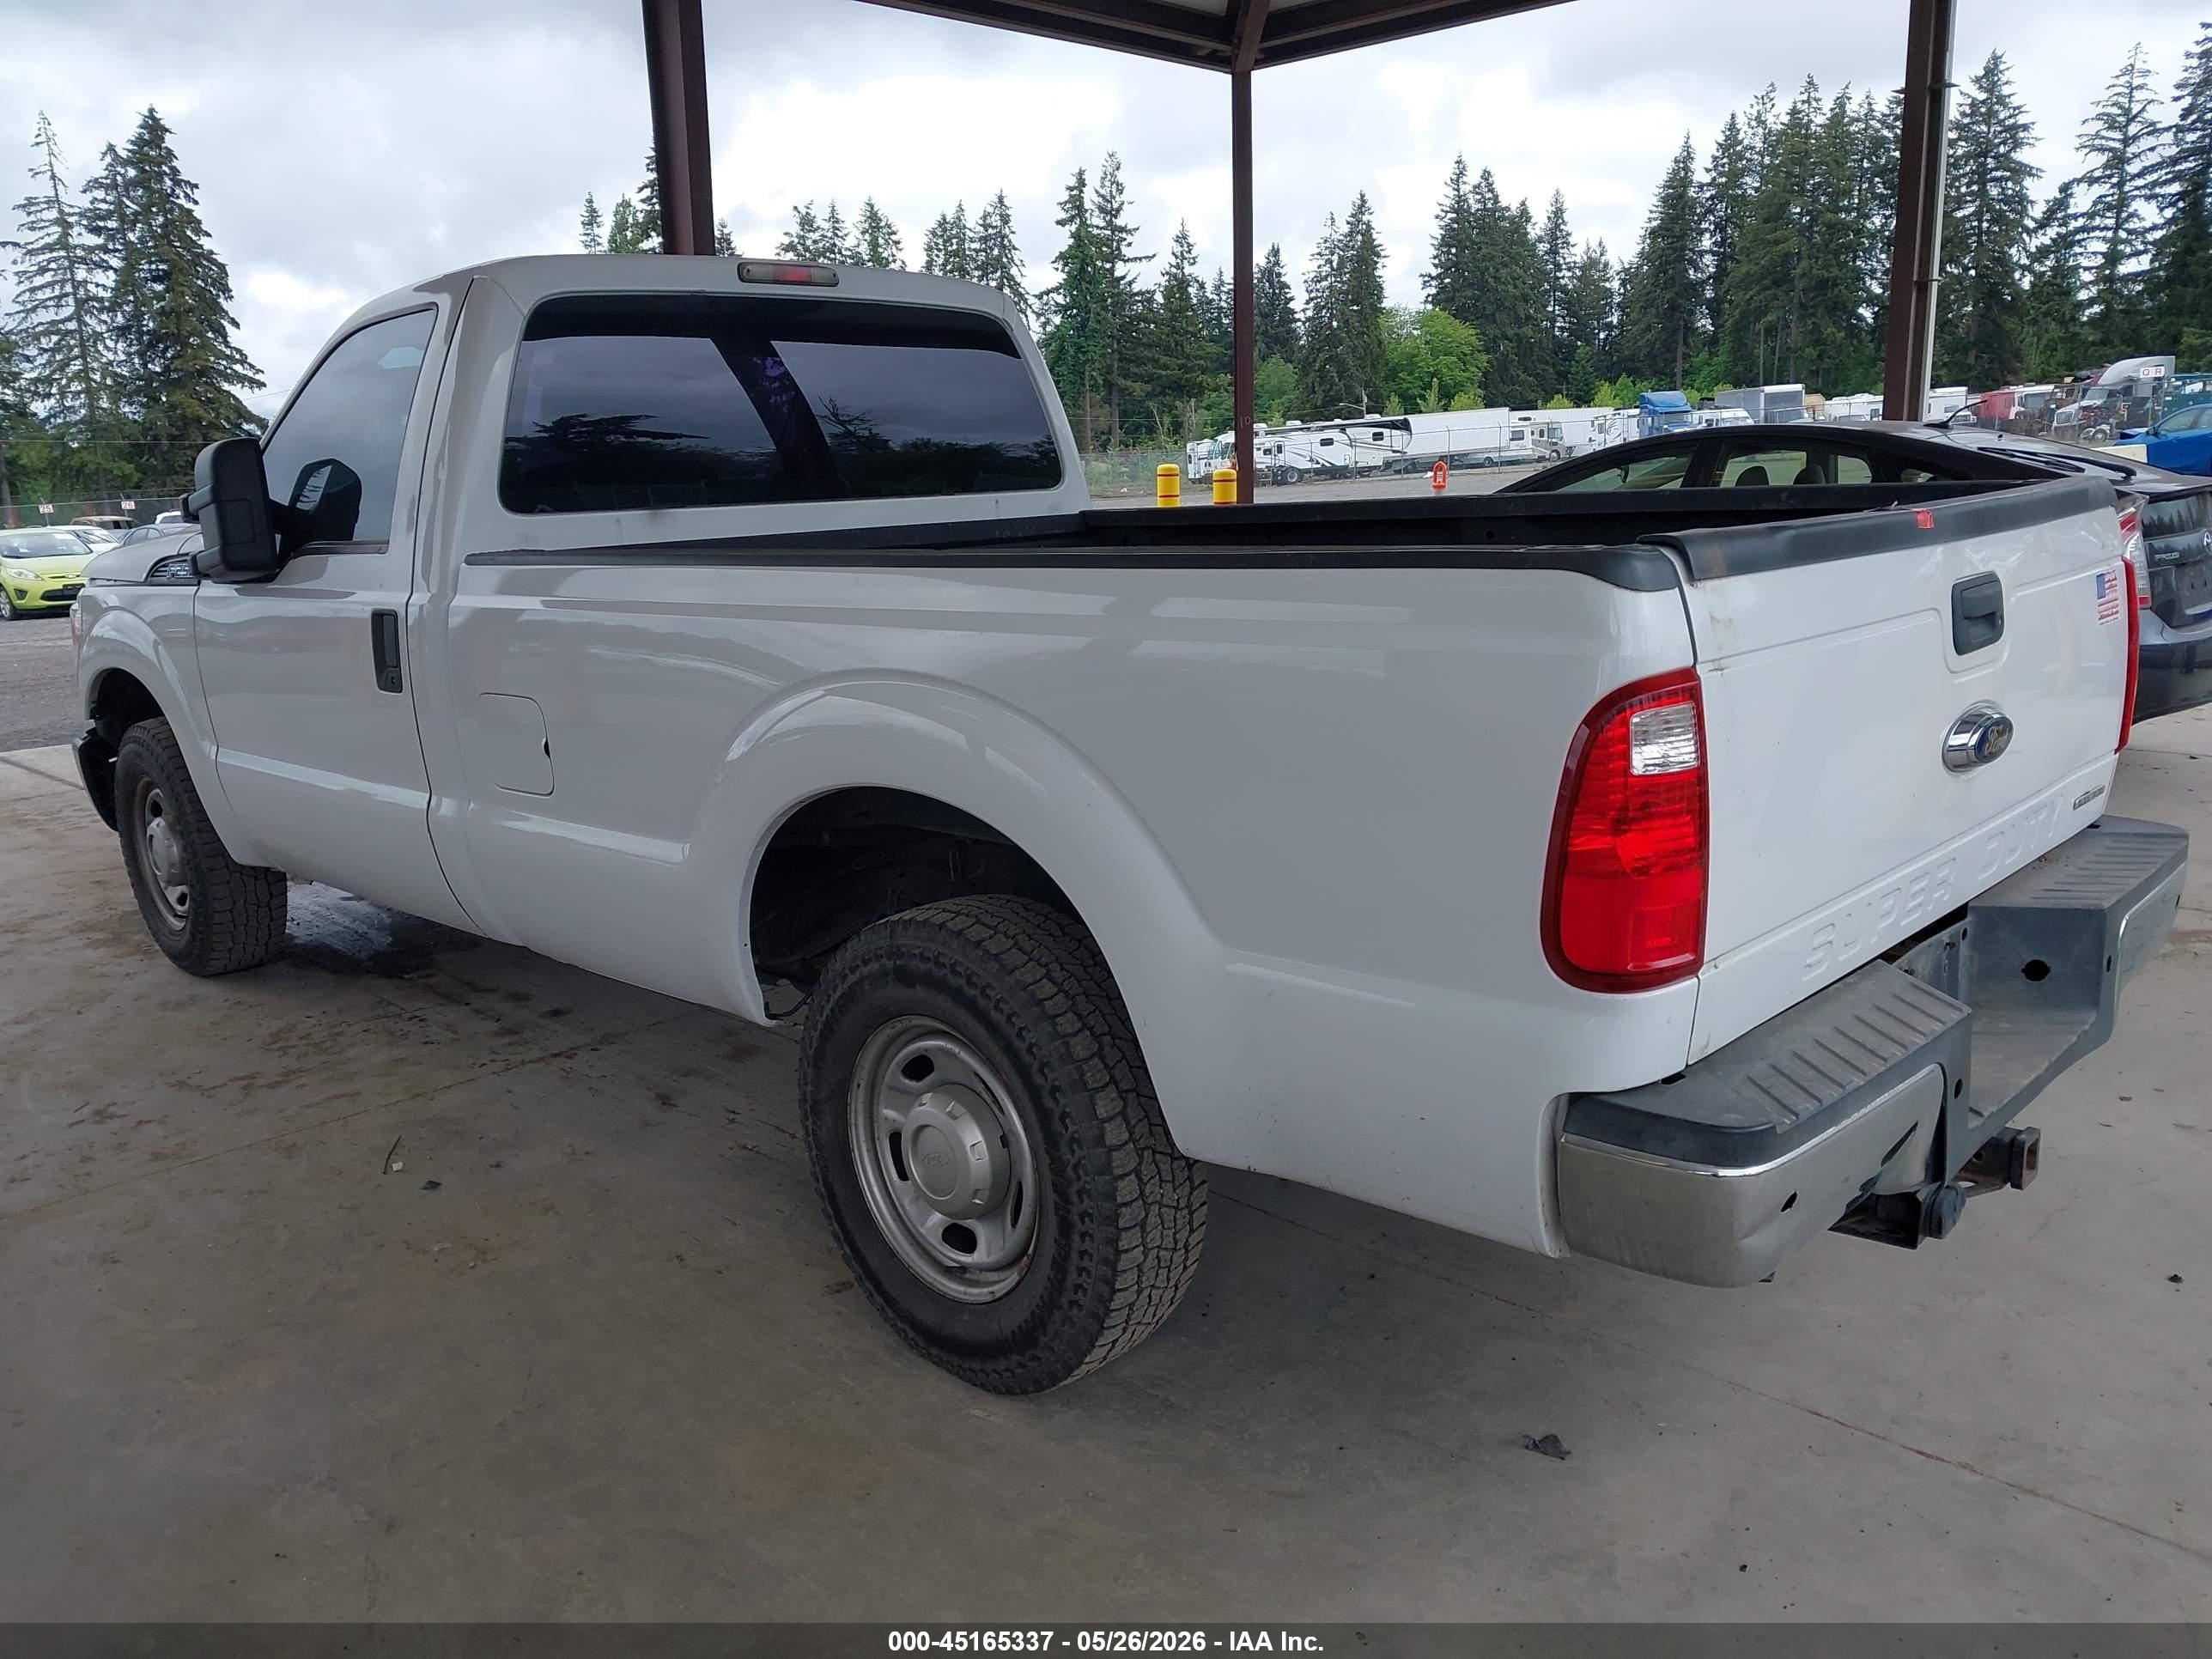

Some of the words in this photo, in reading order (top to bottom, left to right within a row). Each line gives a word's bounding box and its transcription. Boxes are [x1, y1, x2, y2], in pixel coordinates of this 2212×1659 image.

[40, 505, 52, 514] 25
[122, 501, 134, 509] 26
[1801, 857, 1957, 982] SUPER
[1977, 793, 2063, 881] DUTY
